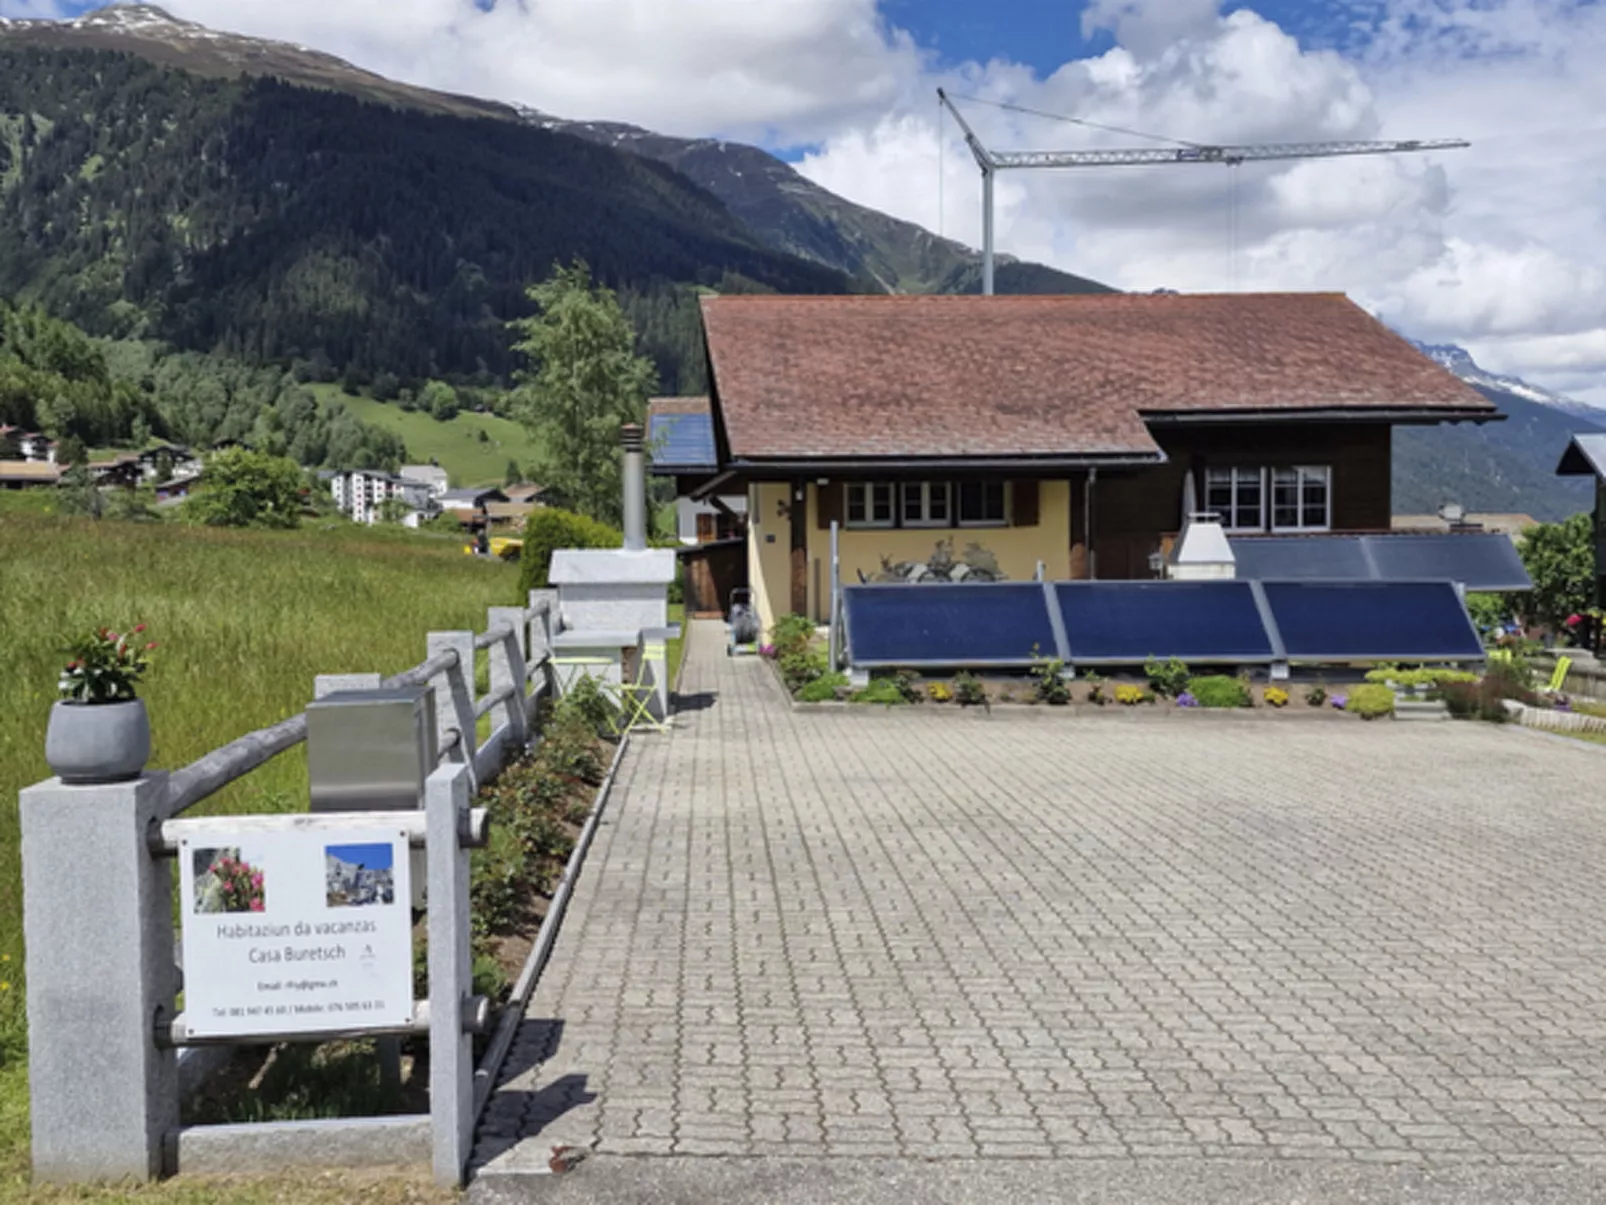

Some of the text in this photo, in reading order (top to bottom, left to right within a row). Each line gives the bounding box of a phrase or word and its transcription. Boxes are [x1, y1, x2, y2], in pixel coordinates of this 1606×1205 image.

[217, 920, 377, 939] Habitaziun da vacanzas
[249, 943, 345, 964] Casa Buretsch
